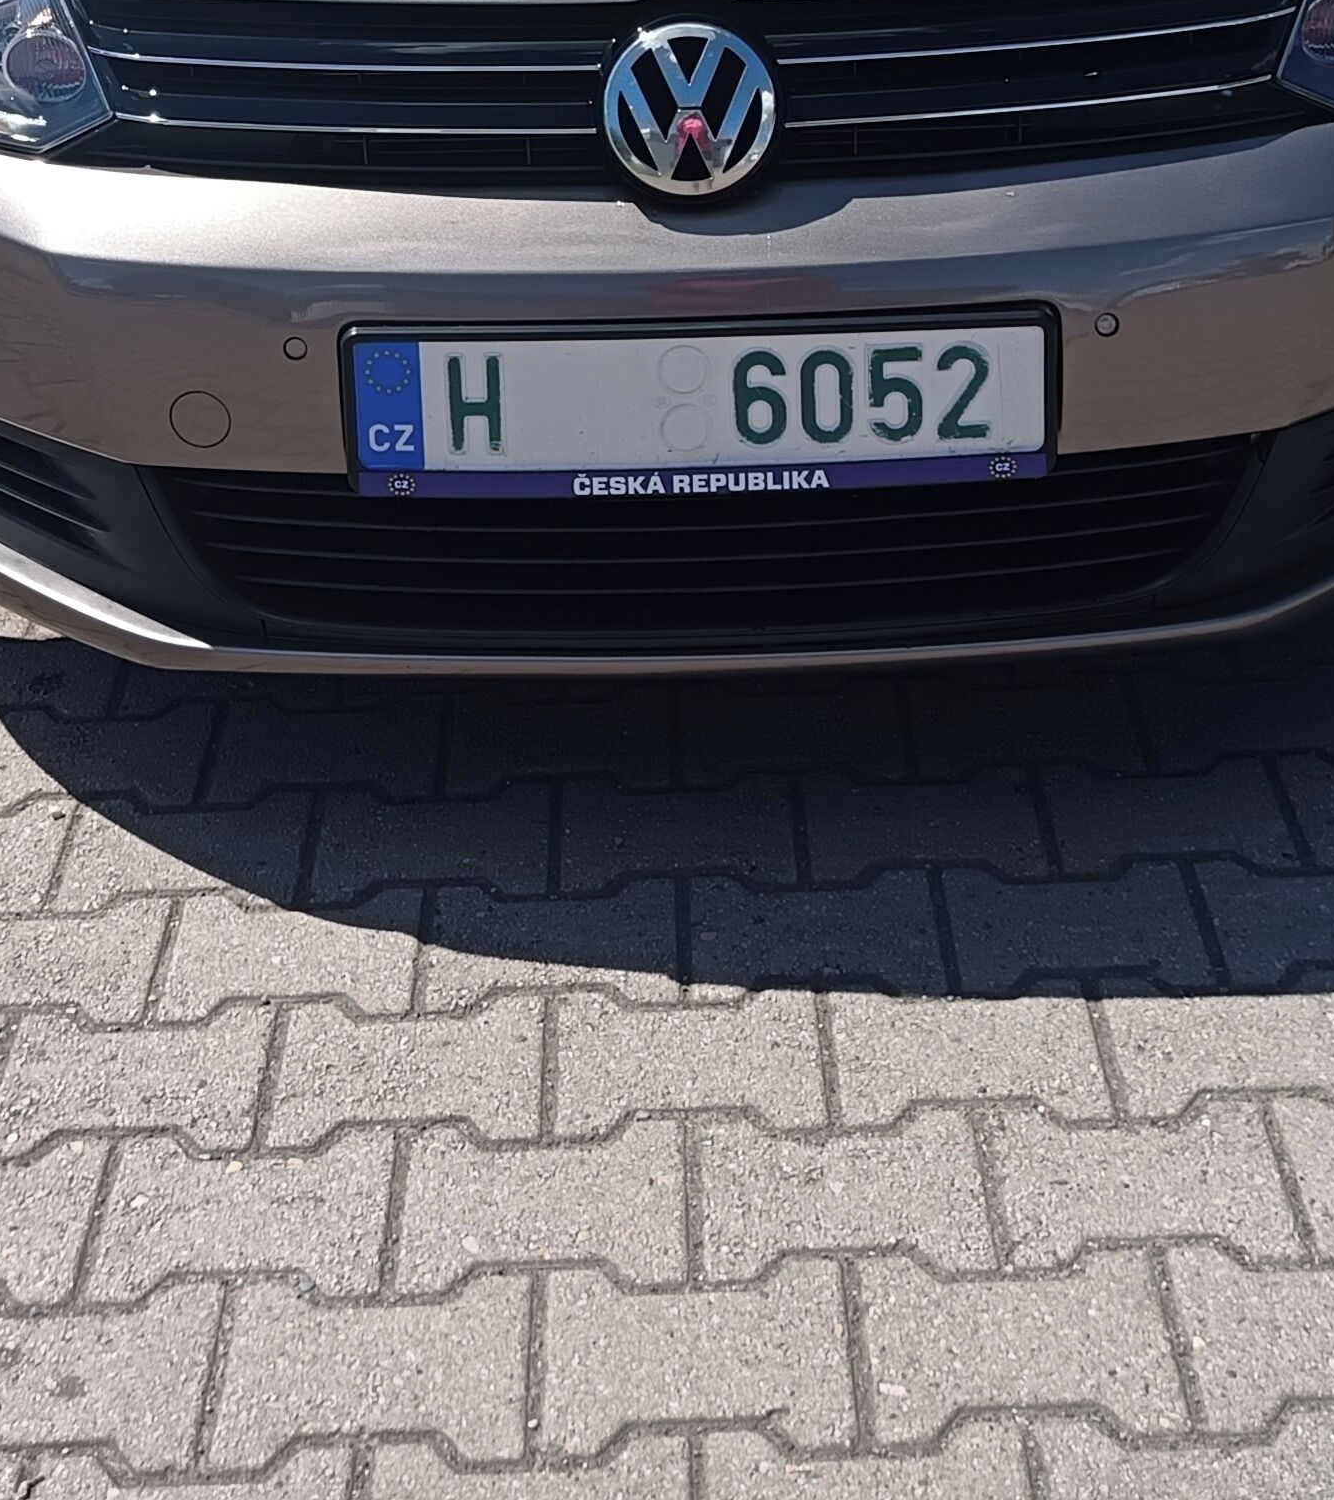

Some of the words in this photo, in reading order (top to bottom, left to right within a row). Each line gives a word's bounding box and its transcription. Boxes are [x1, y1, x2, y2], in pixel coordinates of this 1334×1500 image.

[604, 23, 776, 196] VW
[446, 354, 502, 452] H
[732, 344, 991, 445] 6052
[368, 423, 415, 452] CZ
[994, 462, 1011, 472] CZ
[393, 479, 410, 490] CZ
[572, 471, 666, 497] ČESKÁ
[672, 468, 830, 494] REPUBLIKA
